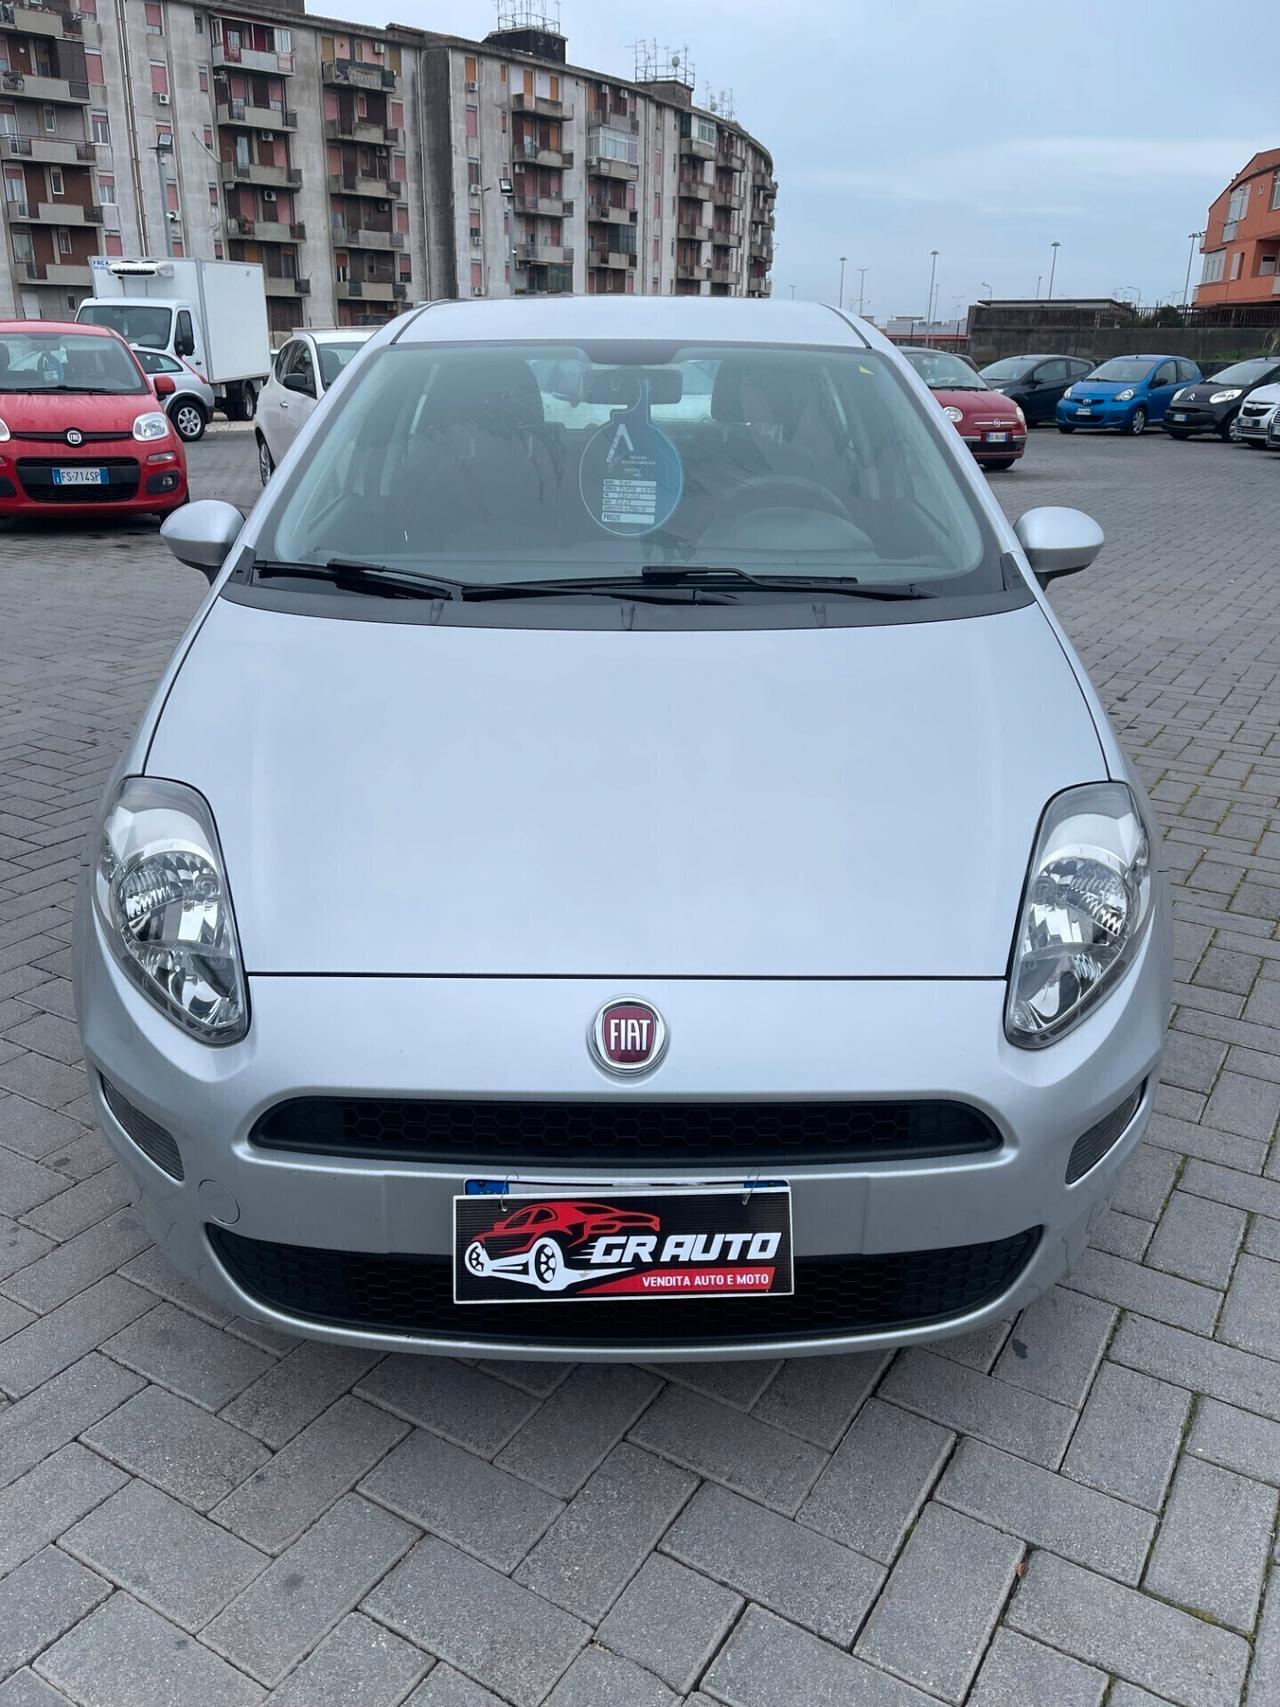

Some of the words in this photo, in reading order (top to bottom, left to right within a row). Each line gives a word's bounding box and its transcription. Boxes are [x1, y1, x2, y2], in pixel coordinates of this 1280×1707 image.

[610, 1019, 651, 1051] FIAT
[590, 1235, 658, 1264] GR
[659, 1232, 782, 1262] AUTO
[642, 1276, 691, 1288] VENDITA
[694, 1275, 724, 1286] AUTO
[727, 1275, 734, 1285] E
[736, 1273, 769, 1285] MOTO
